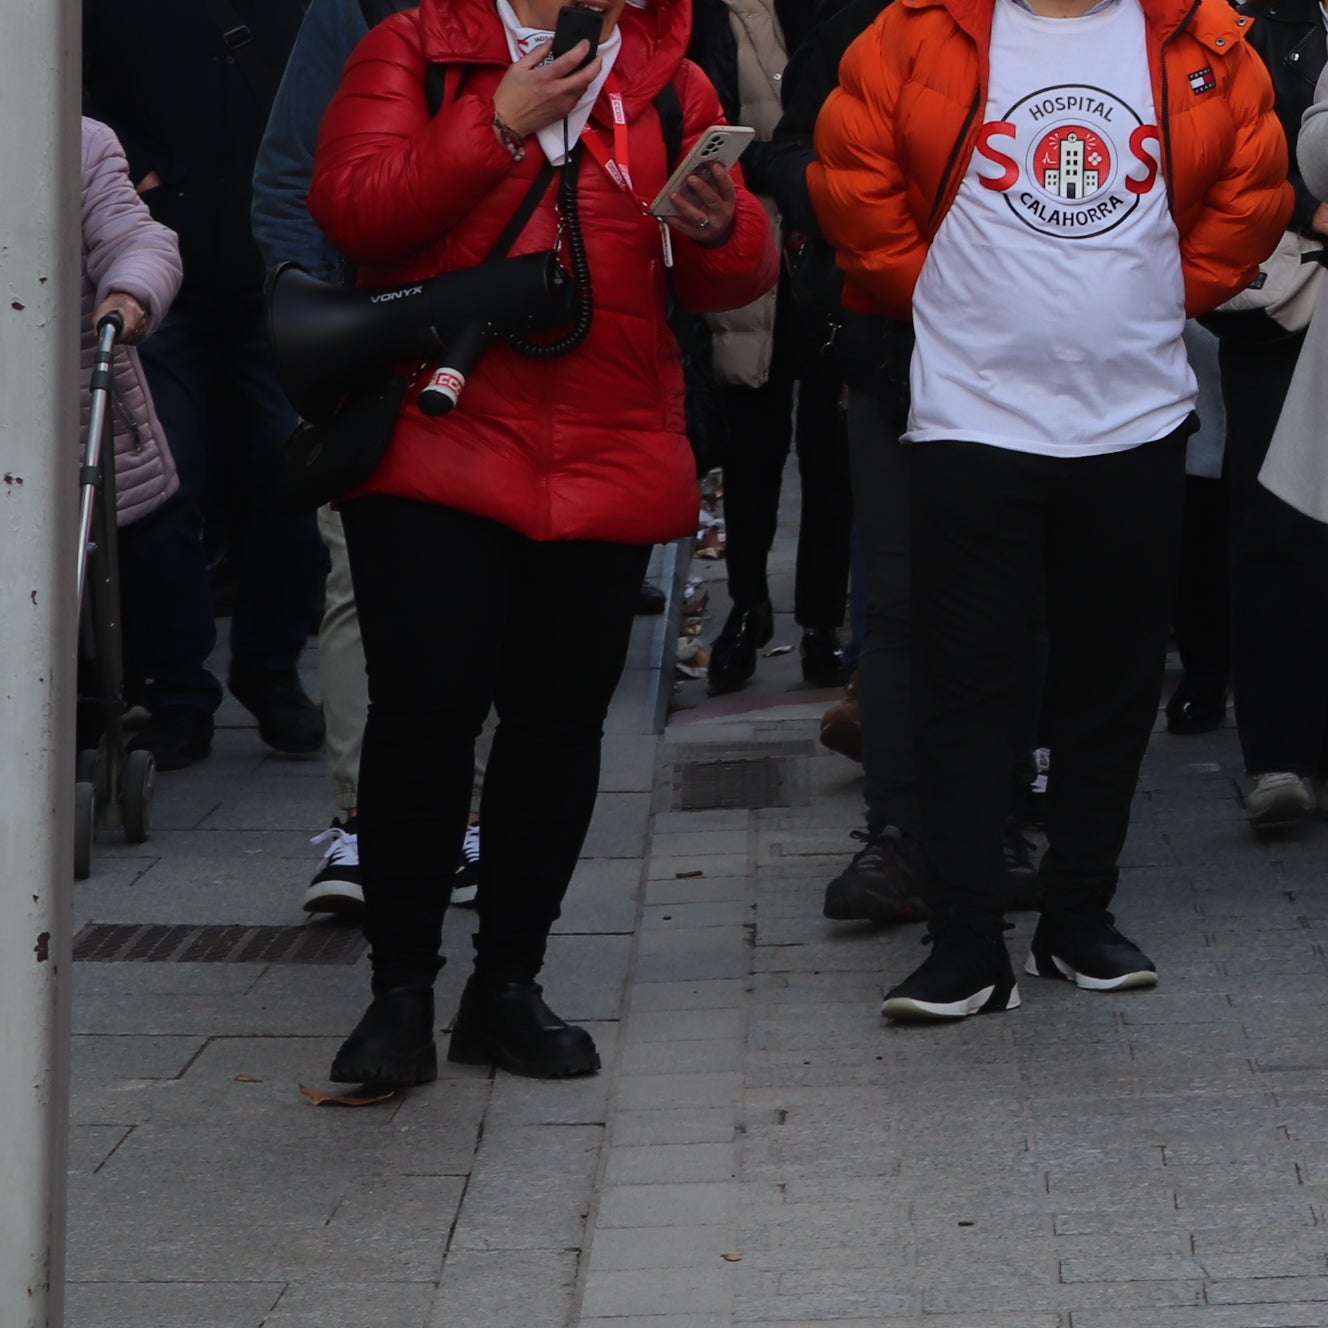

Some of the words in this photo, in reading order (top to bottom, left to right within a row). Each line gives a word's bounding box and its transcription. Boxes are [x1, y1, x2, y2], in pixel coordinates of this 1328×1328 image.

[1029, 96, 1114, 123] HOSPITAL
[1020, 191, 1124, 227] CALAHORRA
[370, 285, 423, 303] VONYX
